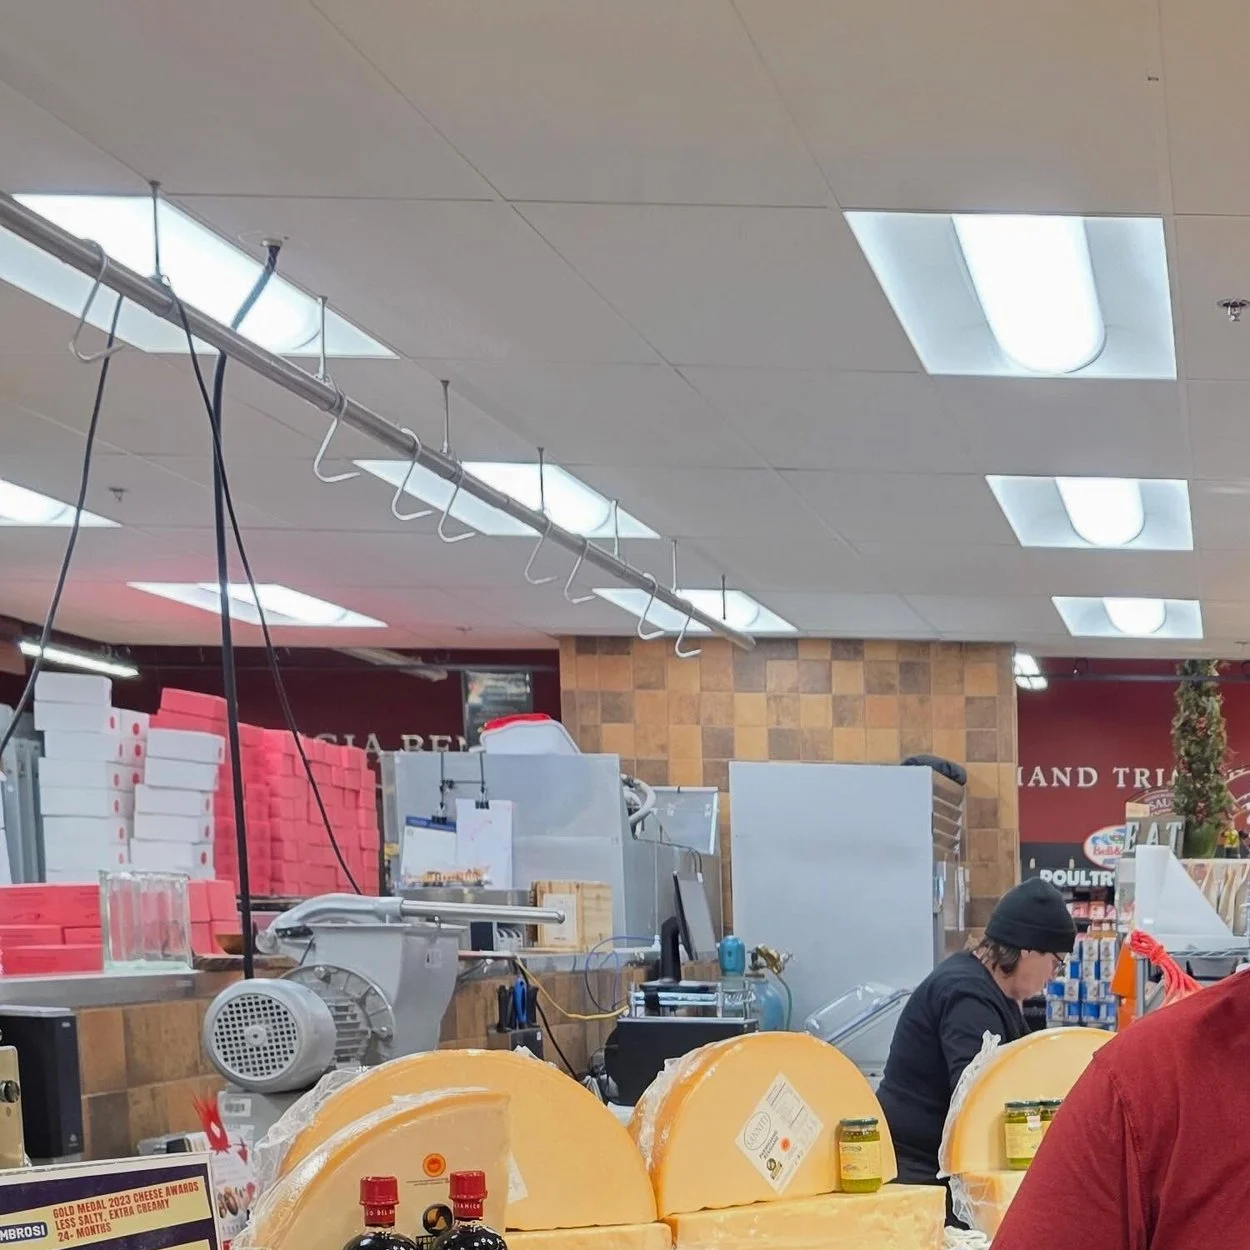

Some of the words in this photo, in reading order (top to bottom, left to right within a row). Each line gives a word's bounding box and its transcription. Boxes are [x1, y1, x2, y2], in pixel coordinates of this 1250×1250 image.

[1124, 821, 1183, 854] EAT
[1040, 868, 1115, 887] POULTR
[53, 1205, 75, 1219] GOLD
[77, 1201, 107, 1214] MEDAL
[109, 1195, 131, 1208] 2023
[133, 1188, 164, 1202] CHEESE
[165, 1181, 199, 1196] AWARDS
[55, 1217, 77, 1231] LESS
[78, 1211, 107, 1226] SALTY,
[109, 1206, 134, 1220] EXTRA
[136, 1199, 170, 1214] CREAMY
[0, 1225, 46, 1241] MBROSI
[76, 1222, 112, 1239] MONTHS
